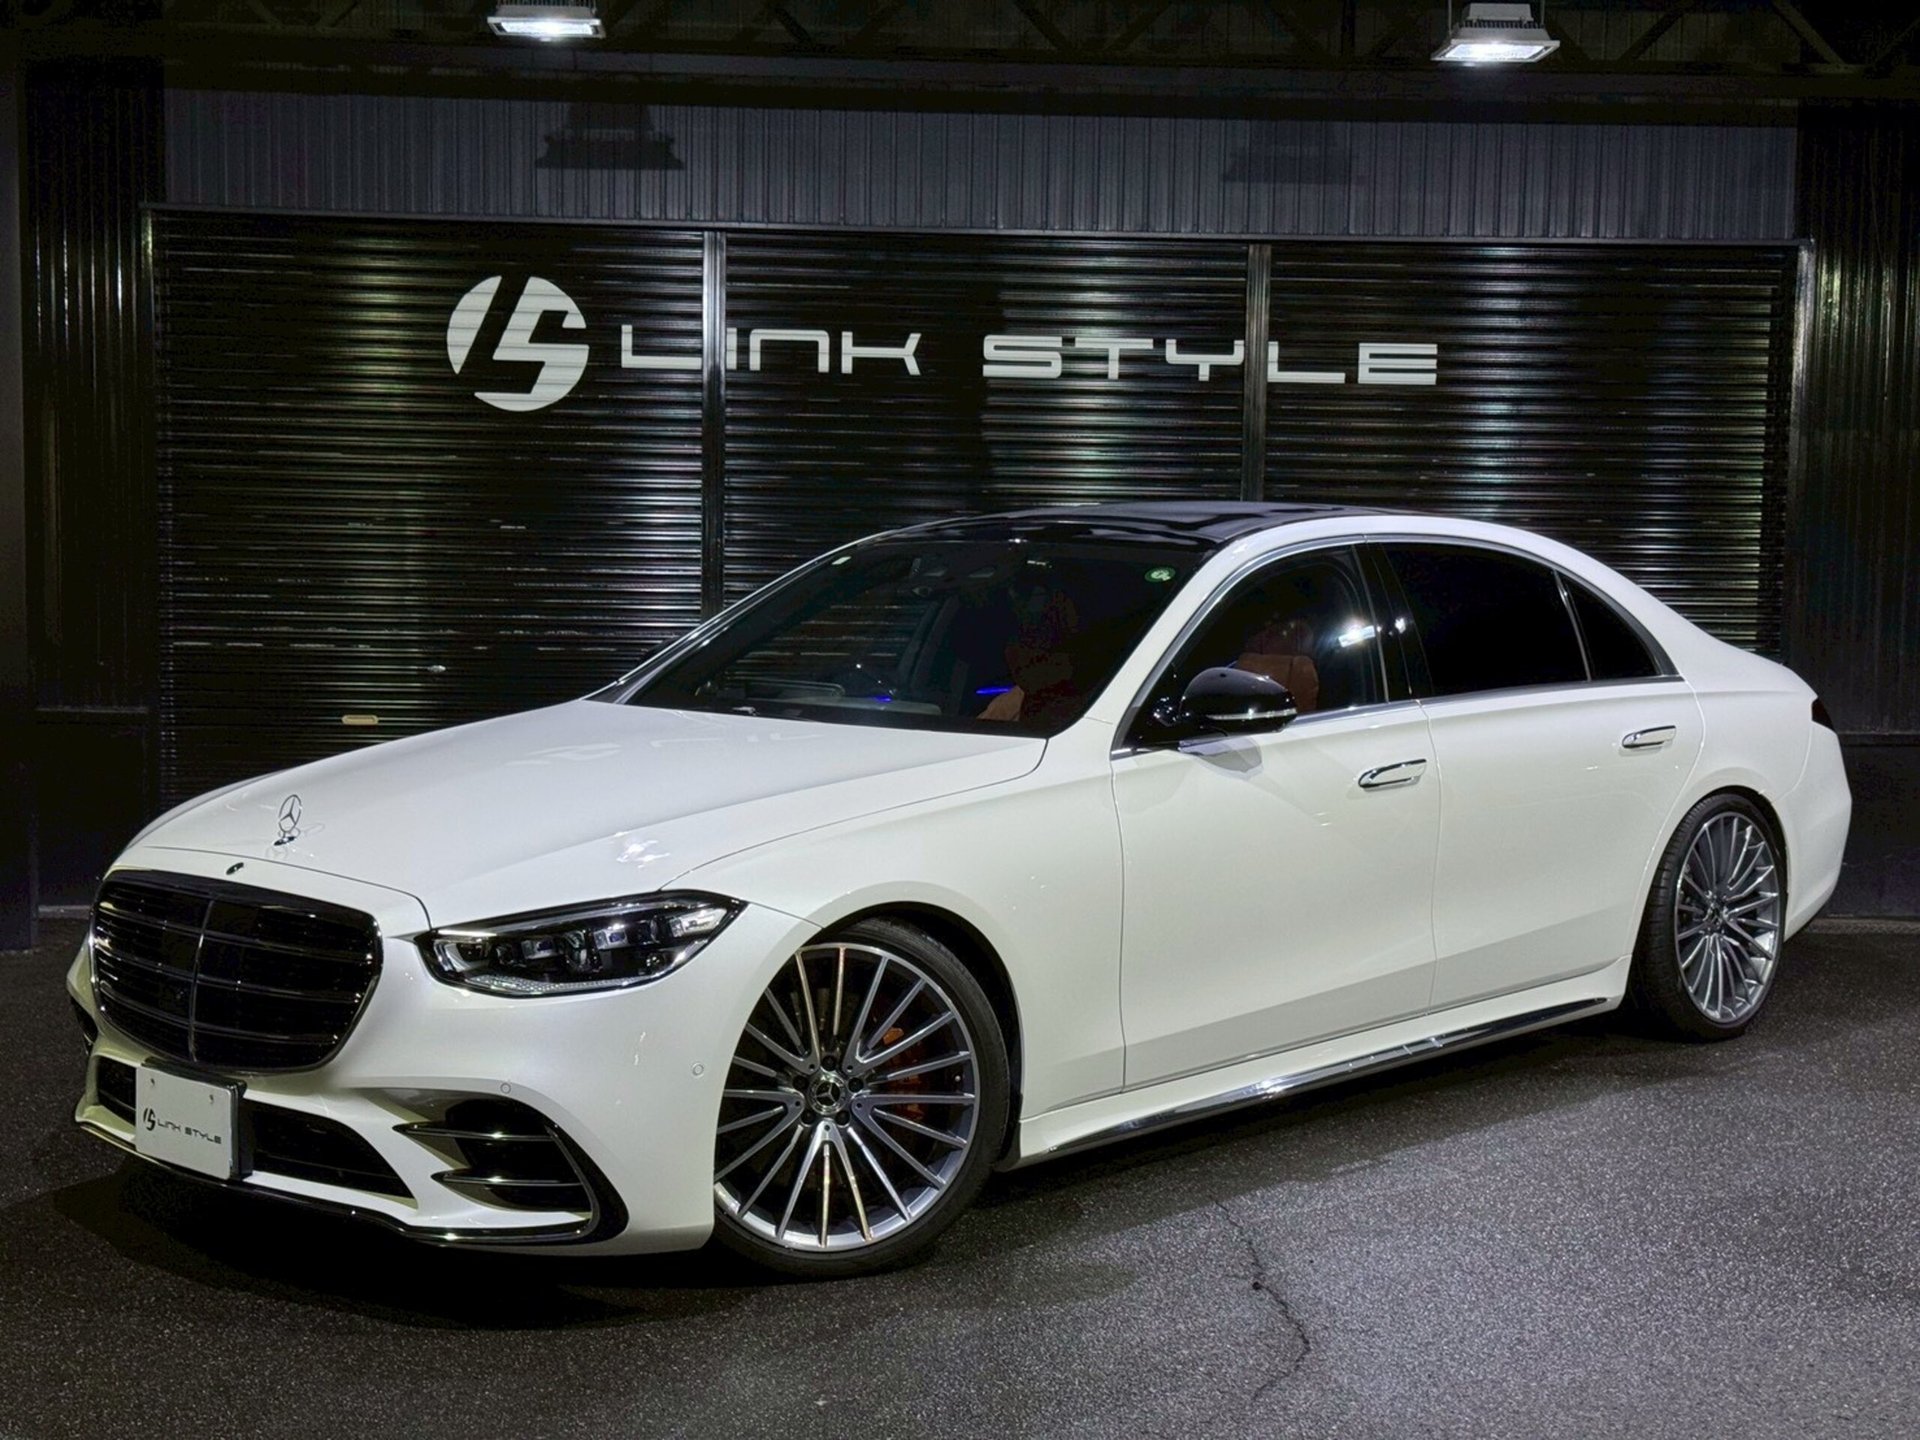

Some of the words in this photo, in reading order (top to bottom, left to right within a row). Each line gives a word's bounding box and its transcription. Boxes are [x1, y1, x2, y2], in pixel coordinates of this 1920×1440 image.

[620, 324, 921, 376] LINK
[982, 334, 1438, 385] STYLE
[184, 1126, 222, 1145] STYLE
